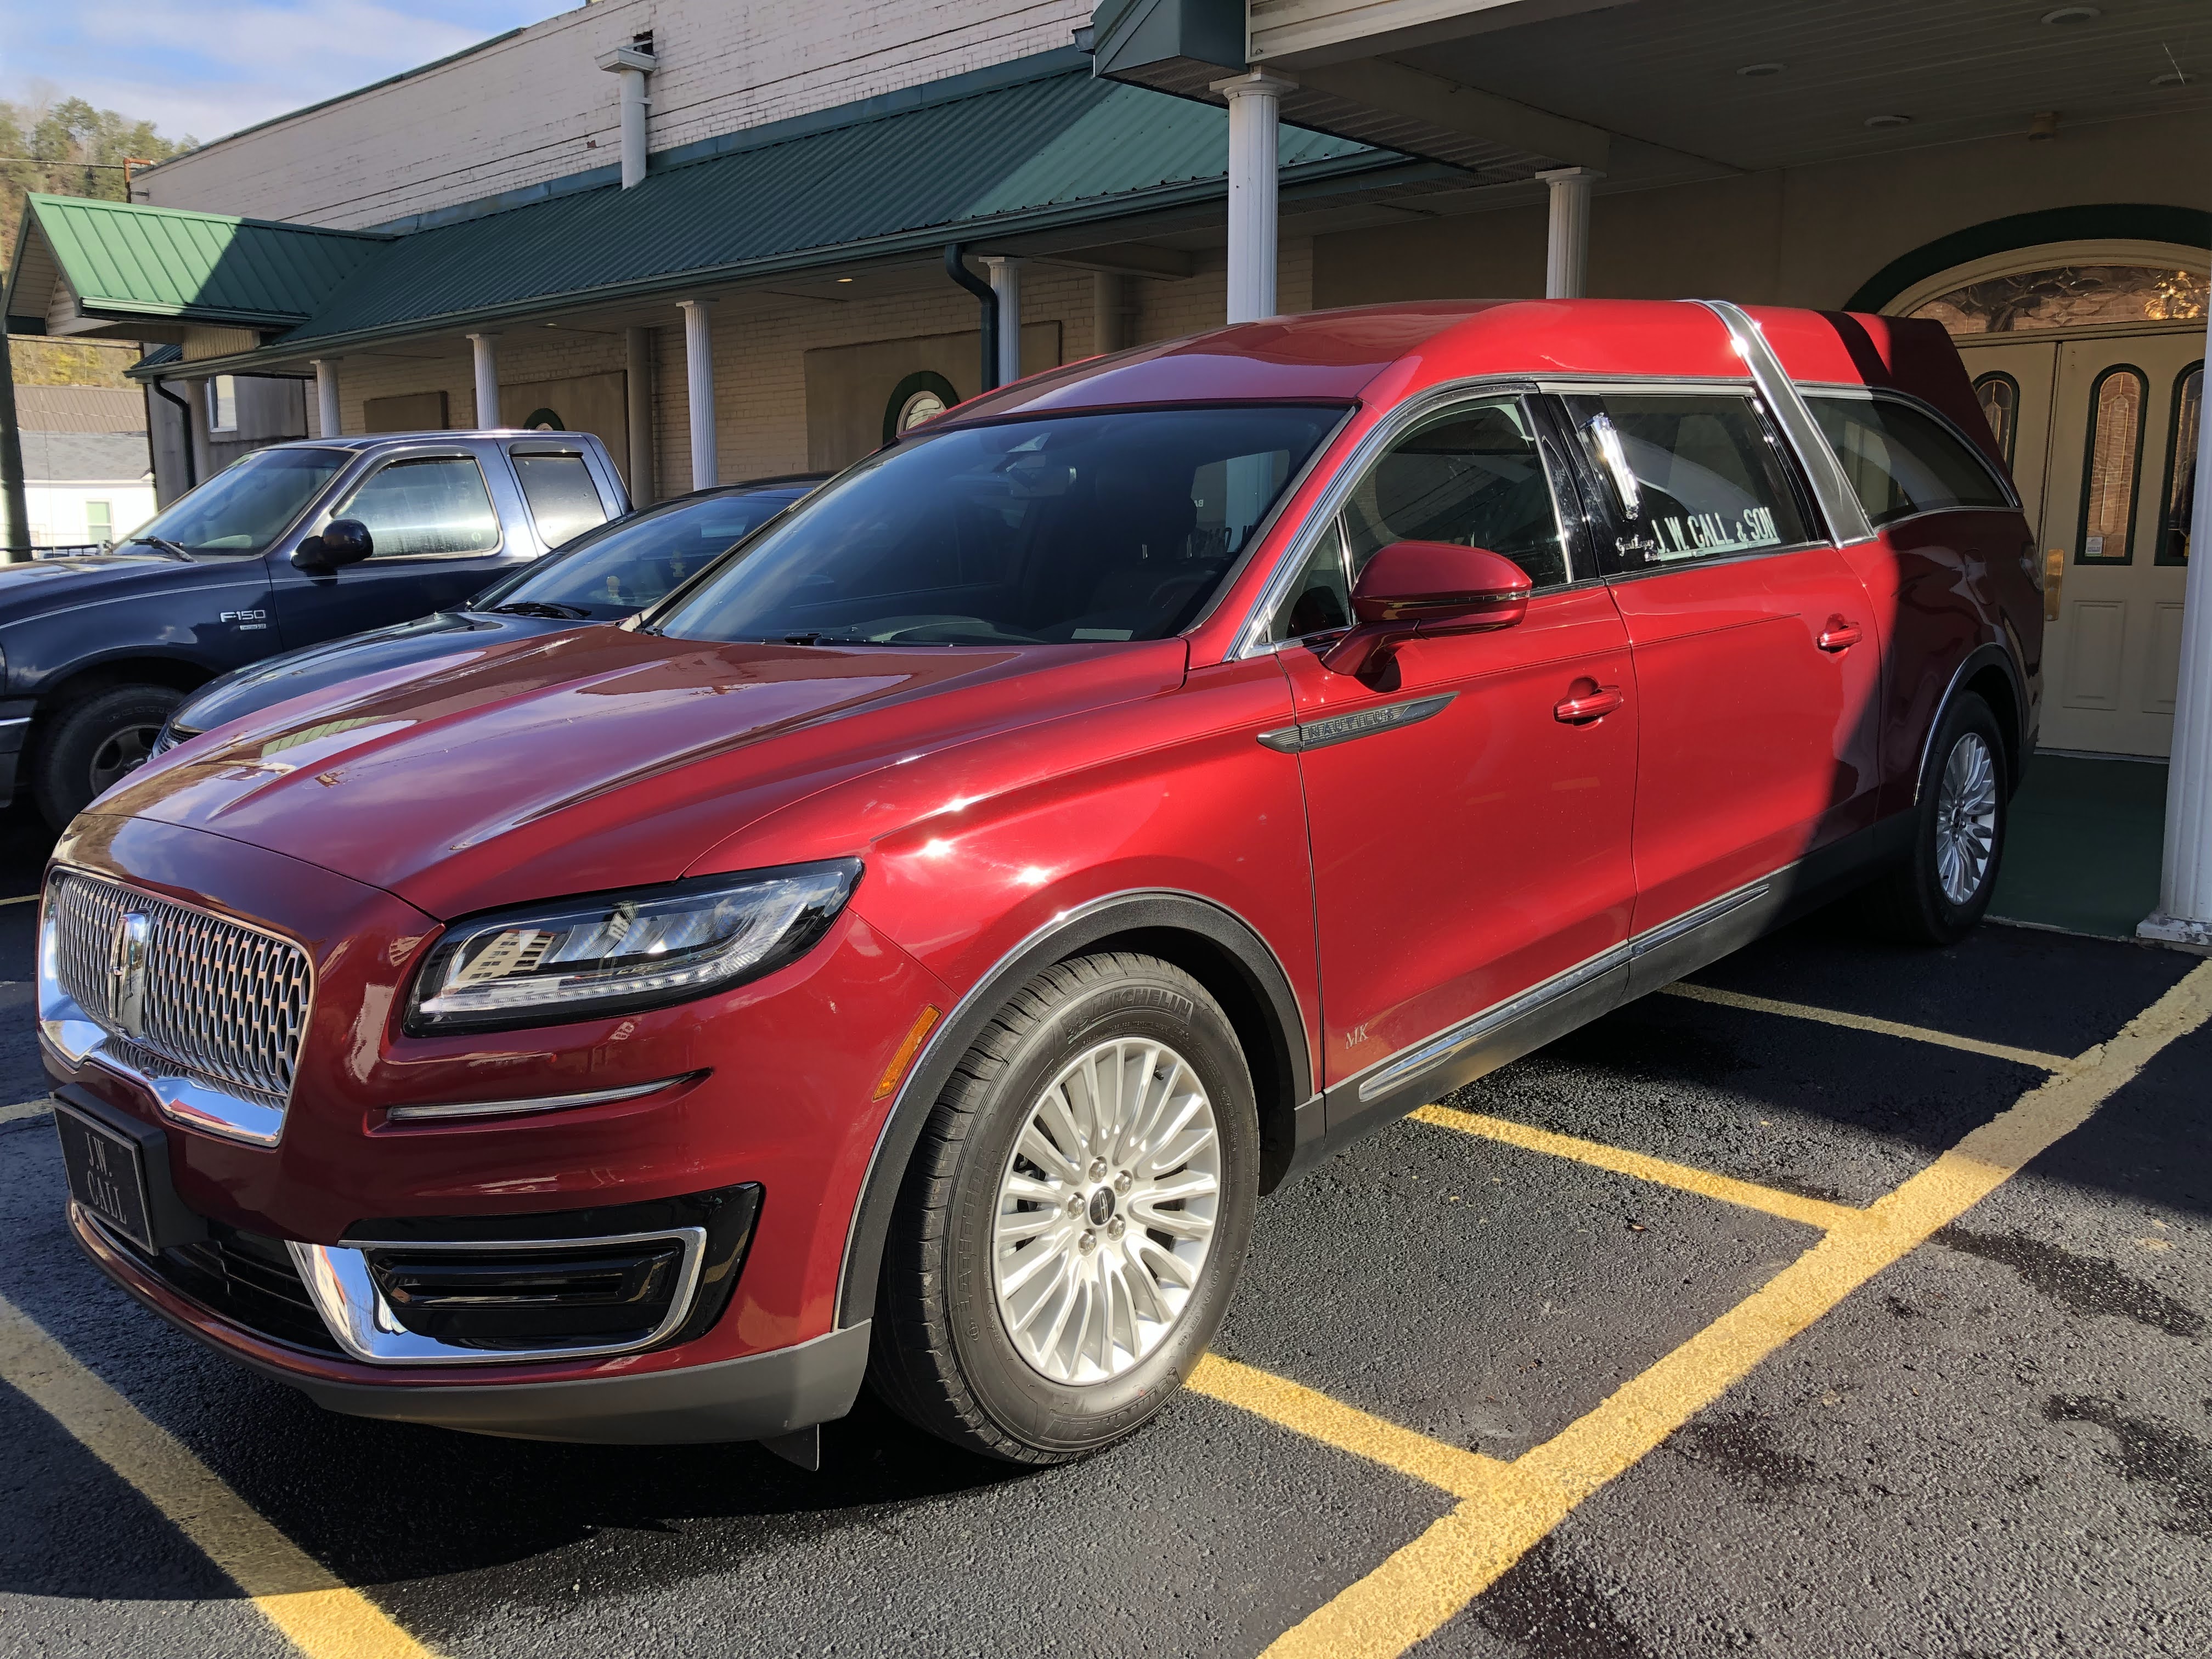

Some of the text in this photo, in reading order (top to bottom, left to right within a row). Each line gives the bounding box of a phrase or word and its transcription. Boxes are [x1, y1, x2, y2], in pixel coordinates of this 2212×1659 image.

[1664, 516, 1690, 551] W.
[1687, 512, 1735, 548] CALL
[1736, 521, 1749, 542] &
[1743, 506, 1778, 540] SON
[1308, 708, 1394, 738] NAUTILUS
[1092, 988, 1192, 1015] MICHELIN
[1345, 1022, 1369, 1049] MK
[84, 1132, 112, 1177] J.W.
[87, 1170, 127, 1224] CALL
